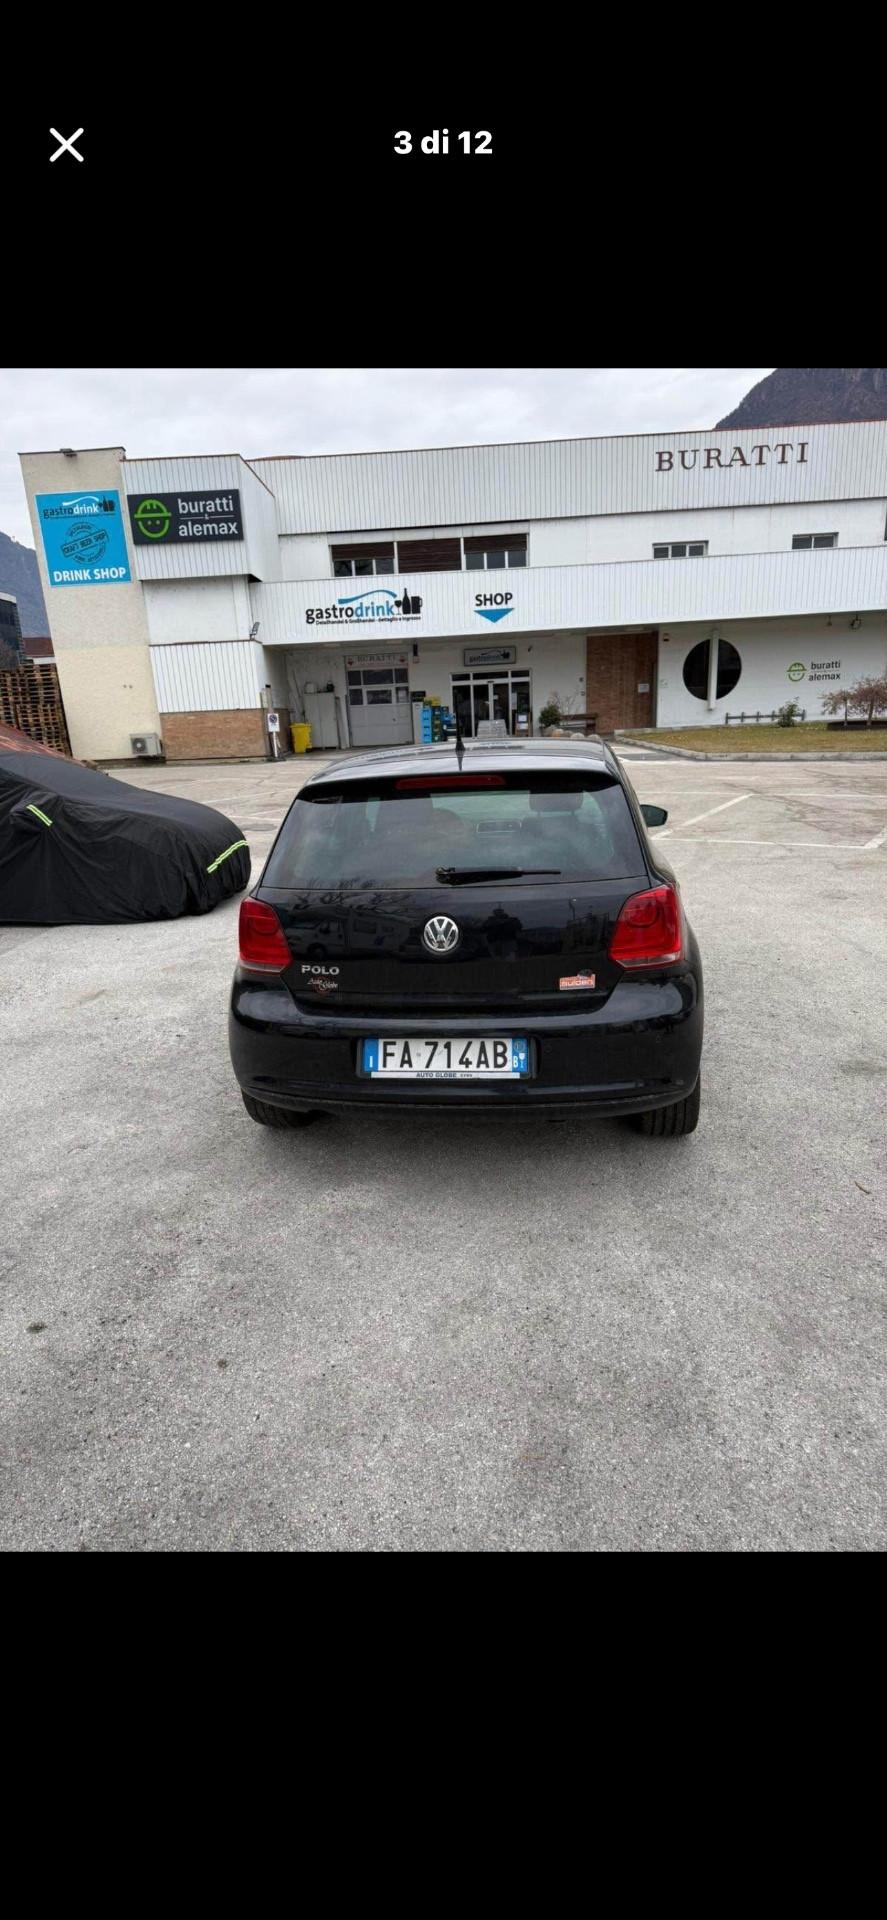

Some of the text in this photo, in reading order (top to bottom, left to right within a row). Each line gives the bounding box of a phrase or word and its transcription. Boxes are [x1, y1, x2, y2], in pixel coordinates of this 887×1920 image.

[655, 442, 809, 471] BURATTI
[43, 503, 99, 519] gastrodrink
[177, 495, 234, 514] buratti
[178, 521, 238, 537] alemax
[53, 567, 126, 582] DRINK SHOP
[475, 592, 513, 608] SHOP
[305, 600, 395, 624] gastrodrink
[810, 660, 841, 670] buratti
[808, 673, 841, 681] alemax
[301, 965, 340, 975] POLO
[382, 1041, 413, 1068] FA
[424, 1041, 508, 1069] 714AB
